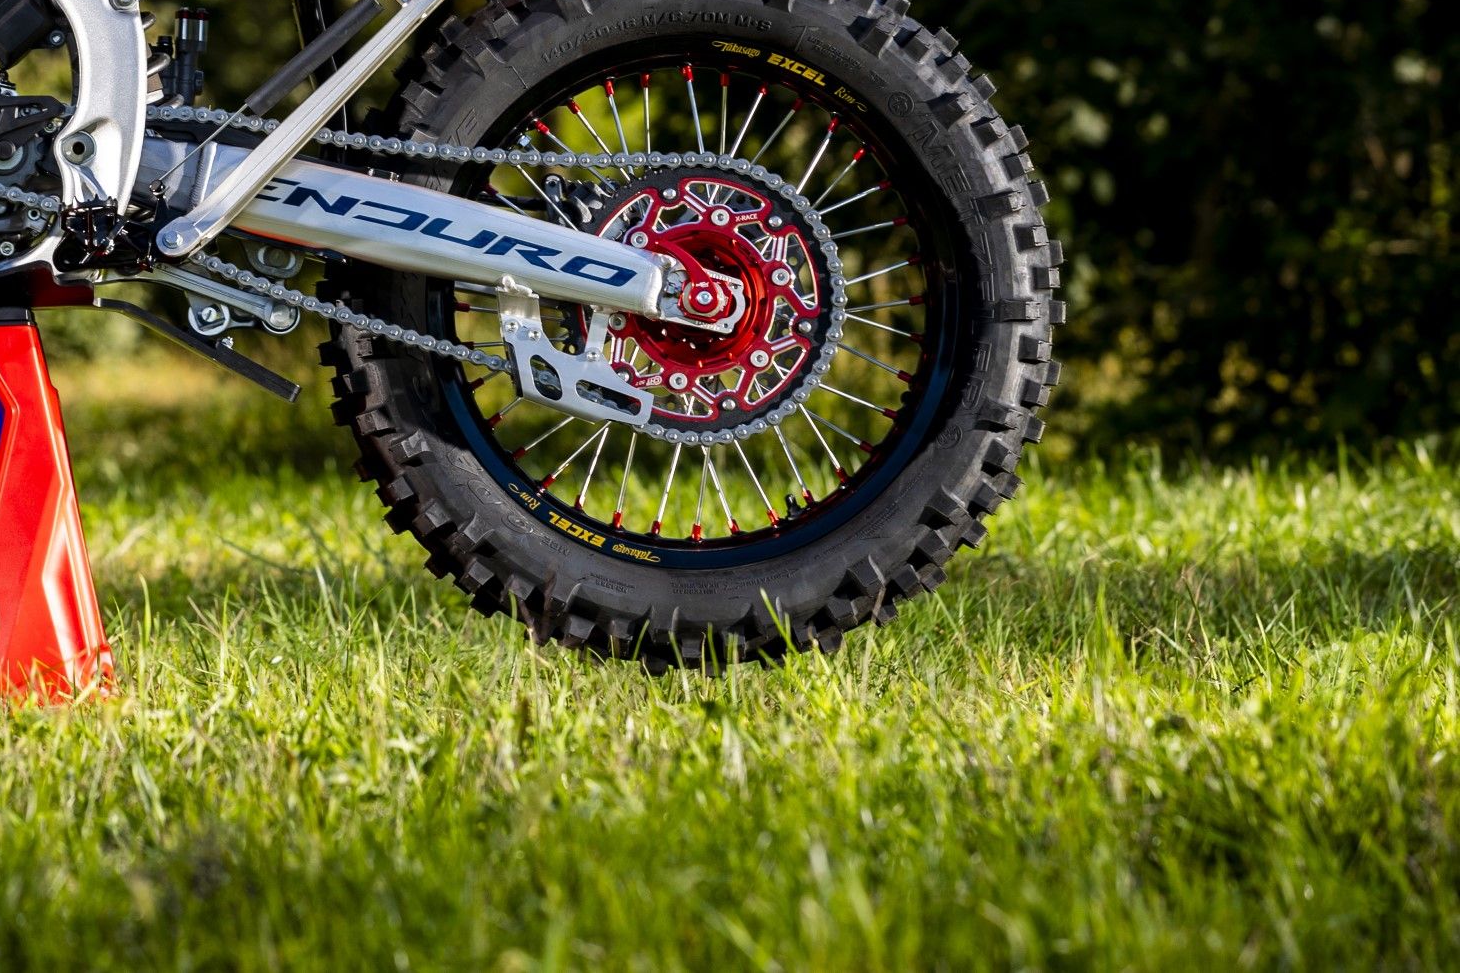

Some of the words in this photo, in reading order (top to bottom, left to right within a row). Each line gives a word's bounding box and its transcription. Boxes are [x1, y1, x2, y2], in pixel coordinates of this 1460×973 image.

[711, 40, 761, 57] Takasago
[767, 52, 827, 87] EXCEL
[834, 86, 863, 109] Rim
[254, 176, 638, 288] ENDURO
[735, 213, 758, 223] X-RACE
[511, 486, 540, 511] Rim
[548, 511, 606, 548] EXCEL
[612, 543, 661, 563] Takasago
